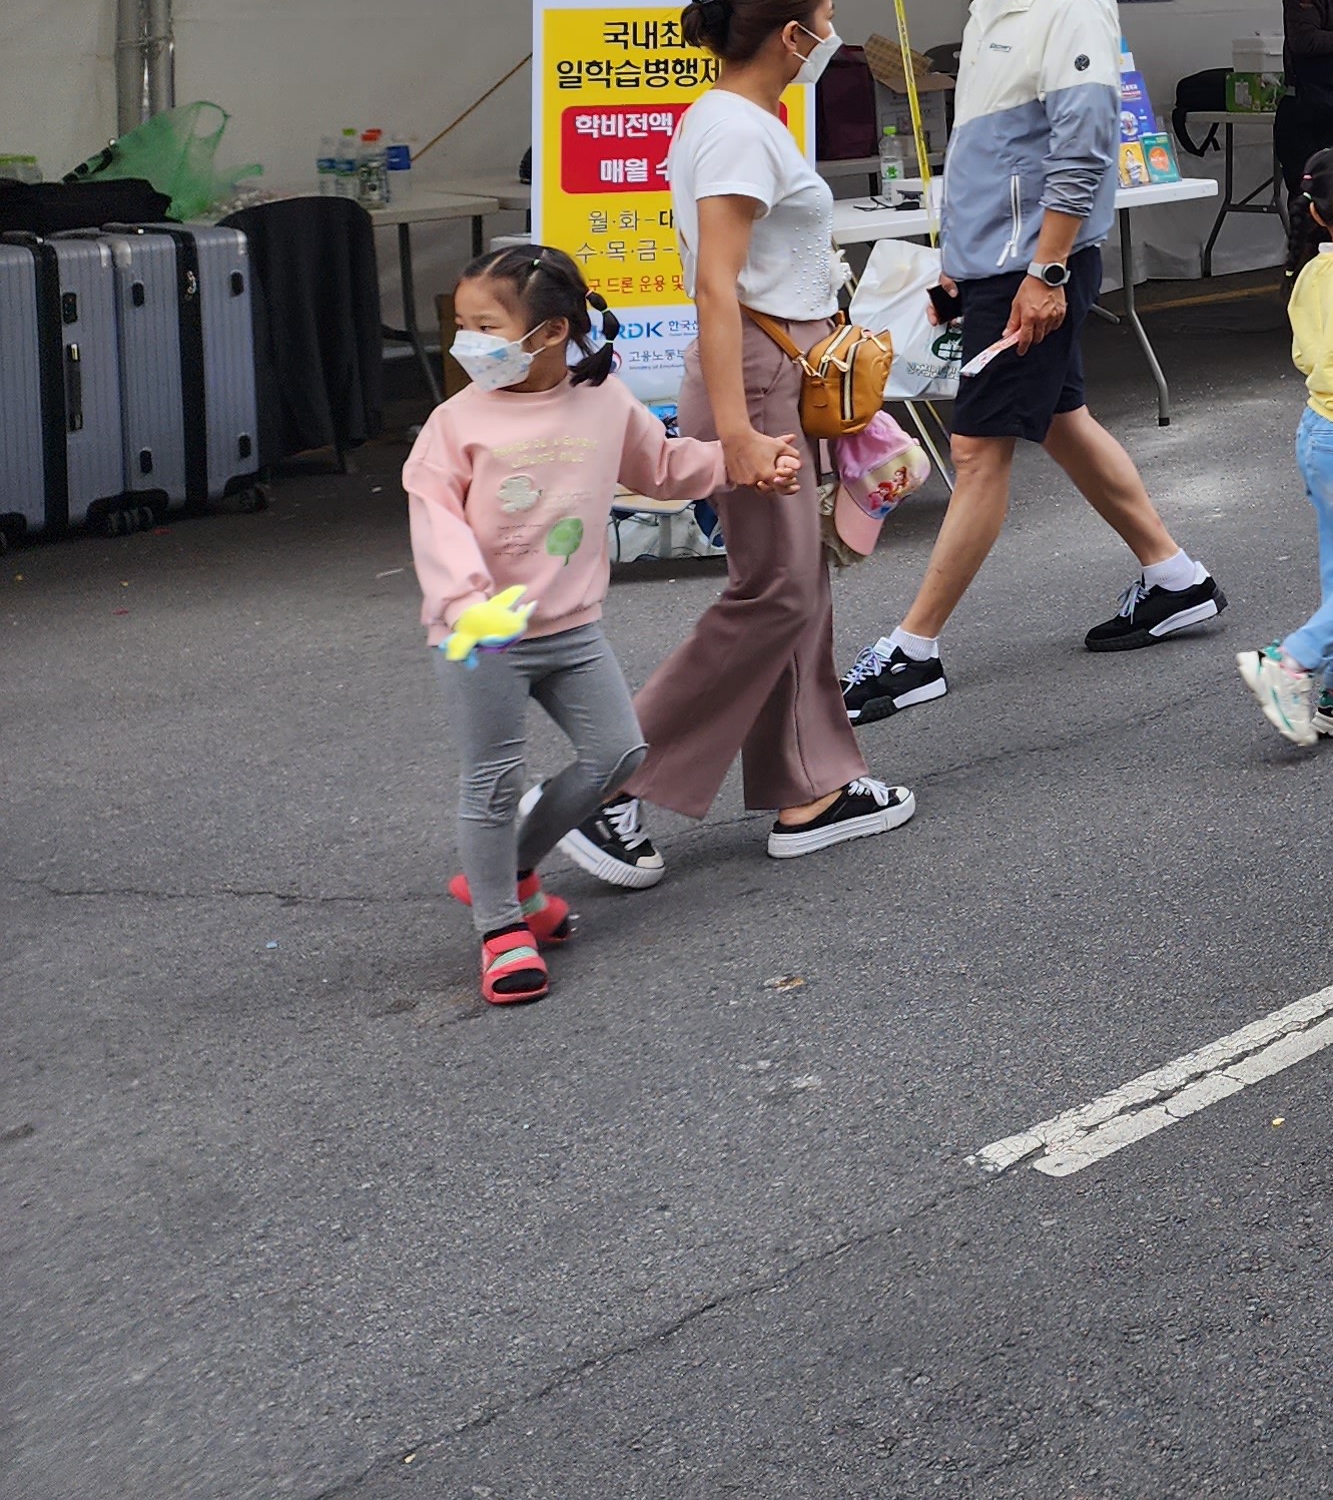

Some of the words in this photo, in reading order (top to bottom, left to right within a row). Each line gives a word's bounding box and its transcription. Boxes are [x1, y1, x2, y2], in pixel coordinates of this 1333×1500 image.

[575, 113, 673, 138] 학비전액
[600, 159, 648, 183] 매월
[607, 276, 633, 294] 드론
[639, 275, 666, 293] 운용
